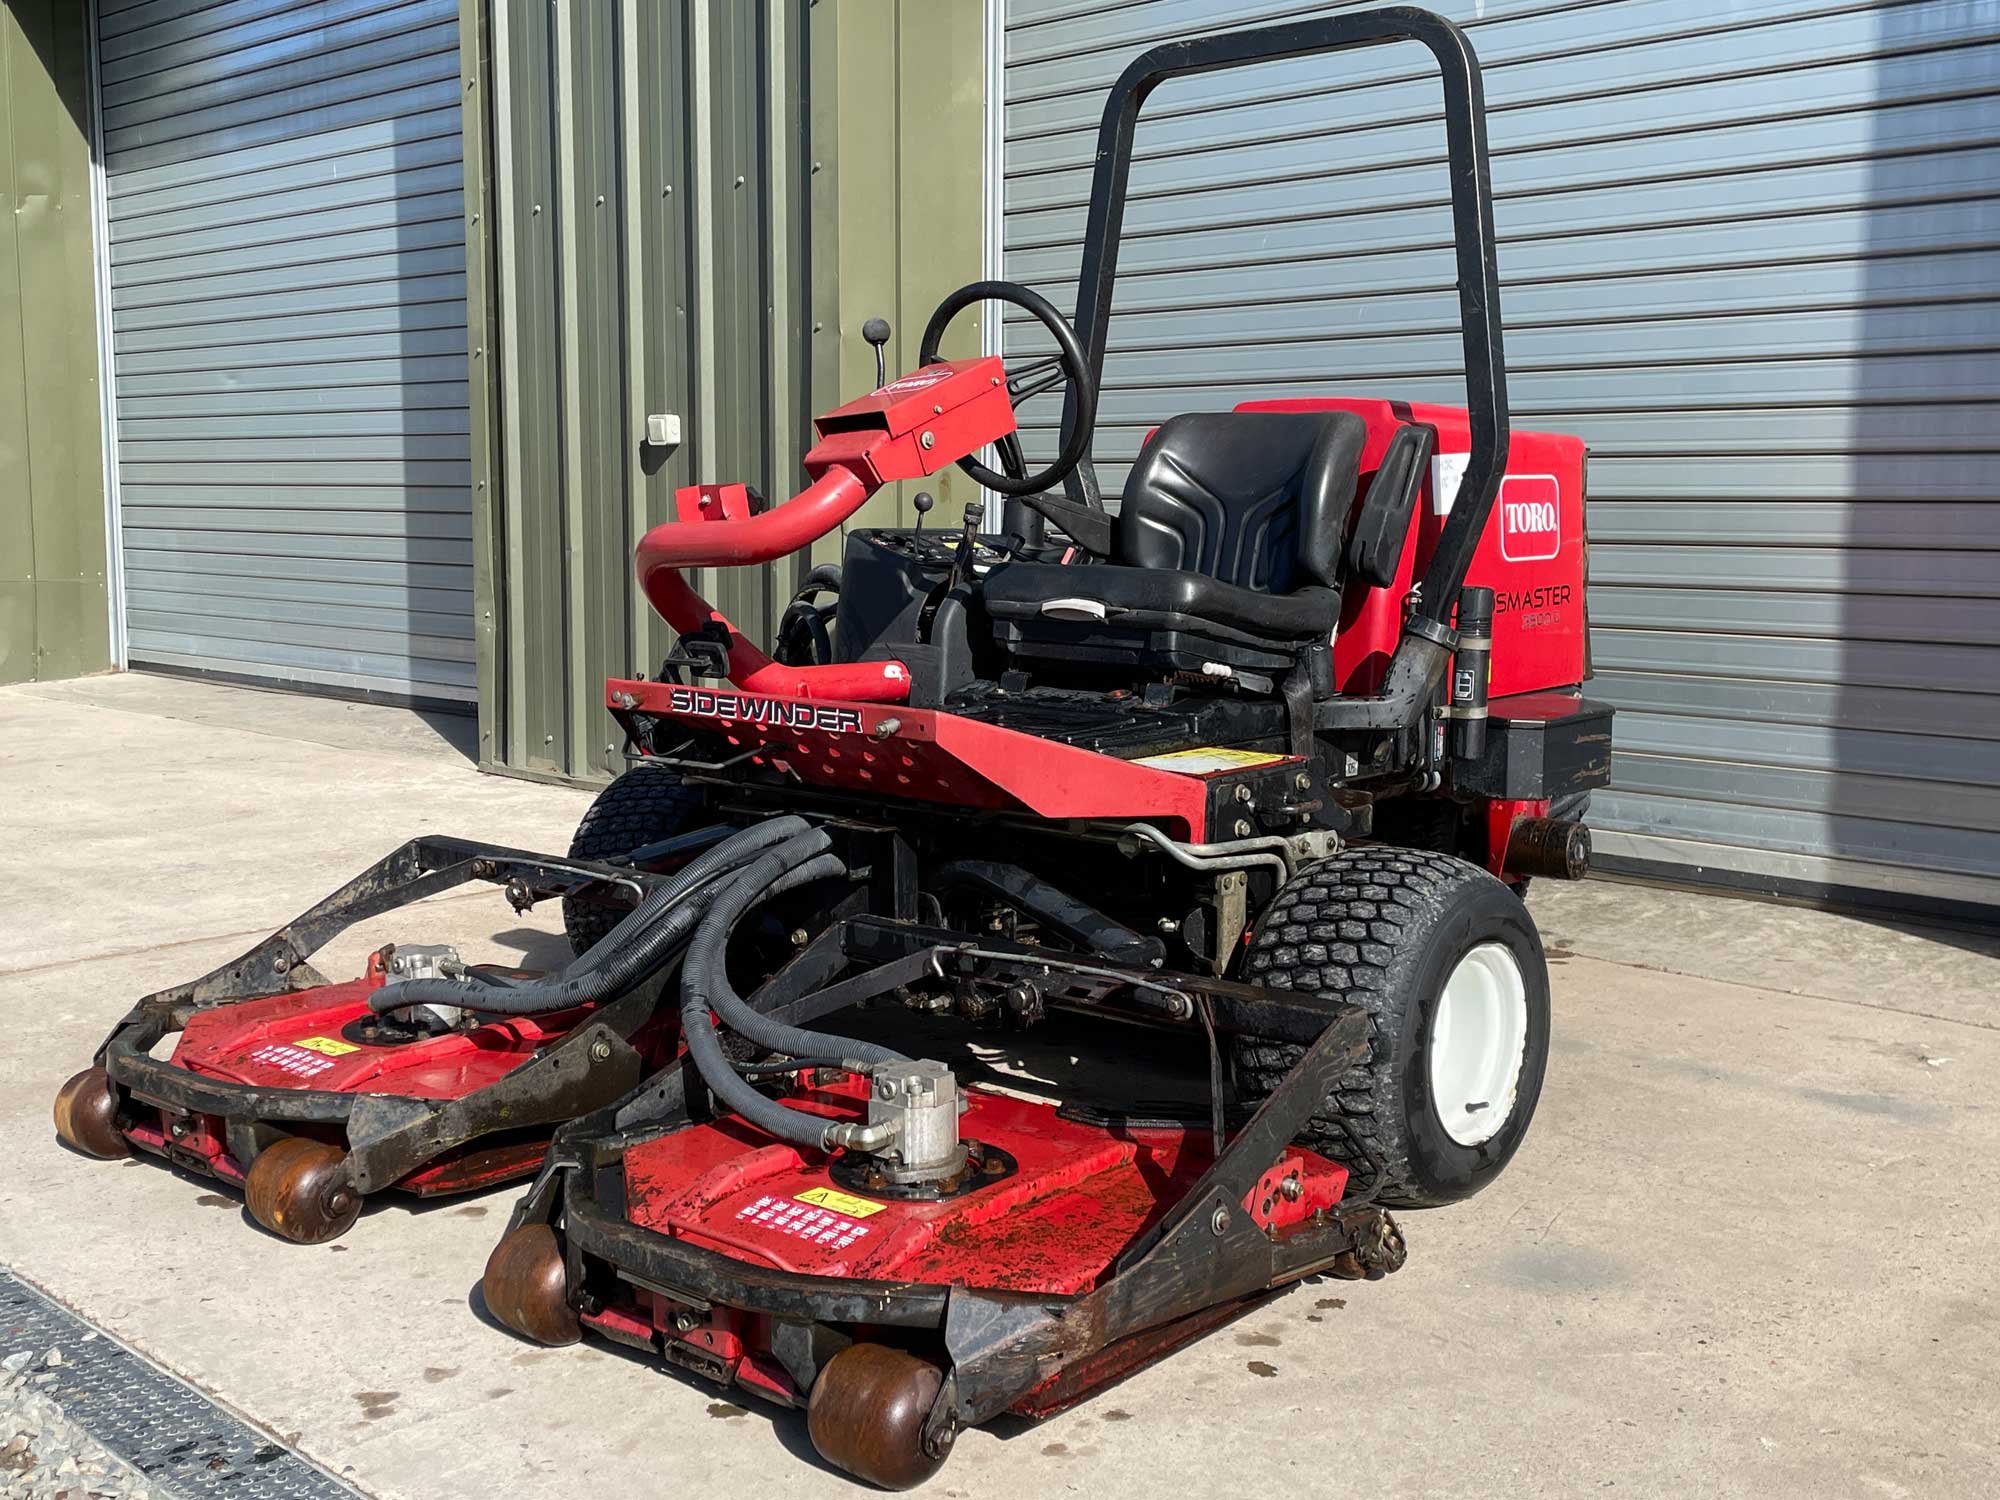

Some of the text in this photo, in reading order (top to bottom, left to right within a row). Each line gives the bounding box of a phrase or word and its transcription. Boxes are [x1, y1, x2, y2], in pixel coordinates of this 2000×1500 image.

[1506, 503, 1555, 533] TORO
[1494, 585, 1571, 614] SMASTER
[670, 689, 864, 733] SIDEWINDER
